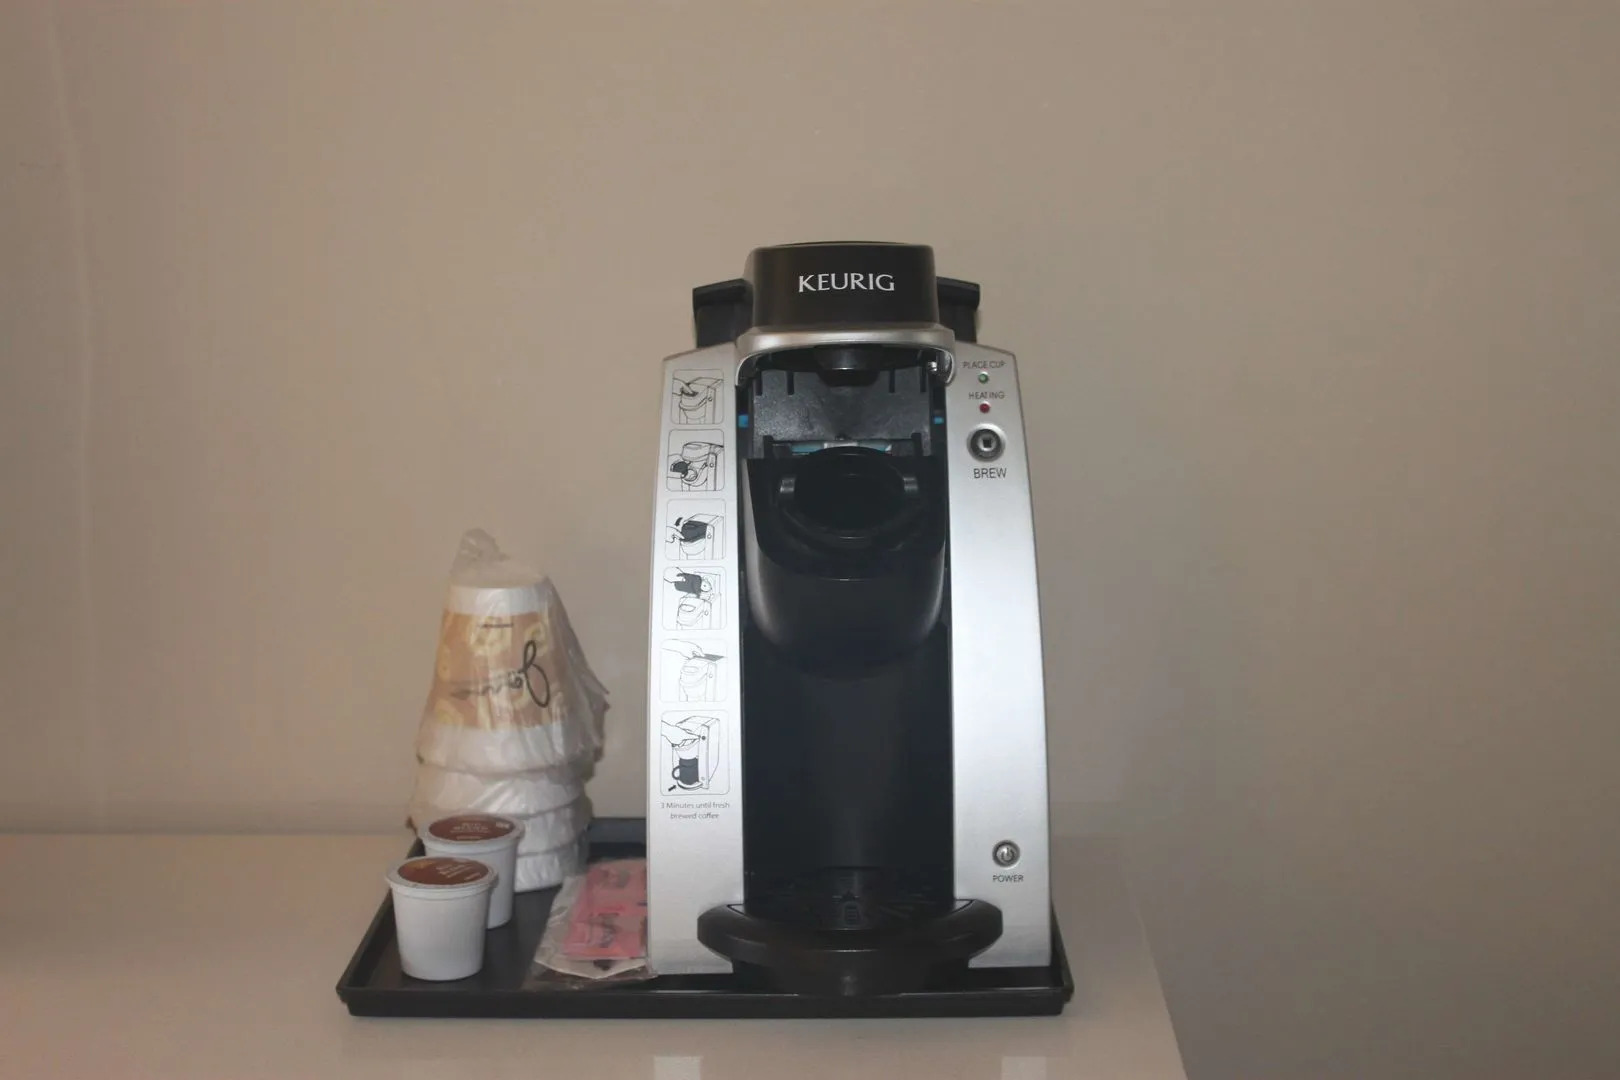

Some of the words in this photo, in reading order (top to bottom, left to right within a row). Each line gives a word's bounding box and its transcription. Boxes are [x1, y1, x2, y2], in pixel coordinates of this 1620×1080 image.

[798, 272, 895, 293] KEURIG
[962, 360, 988, 369] PLACE
[990, 360, 1006, 369] CUP
[968, 391, 1005, 400] HEATING
[973, 467, 1007, 479] BREW
[695, 801, 711, 809] until
[712, 801, 730, 809] fresh
[992, 874, 1024, 883] POWER
